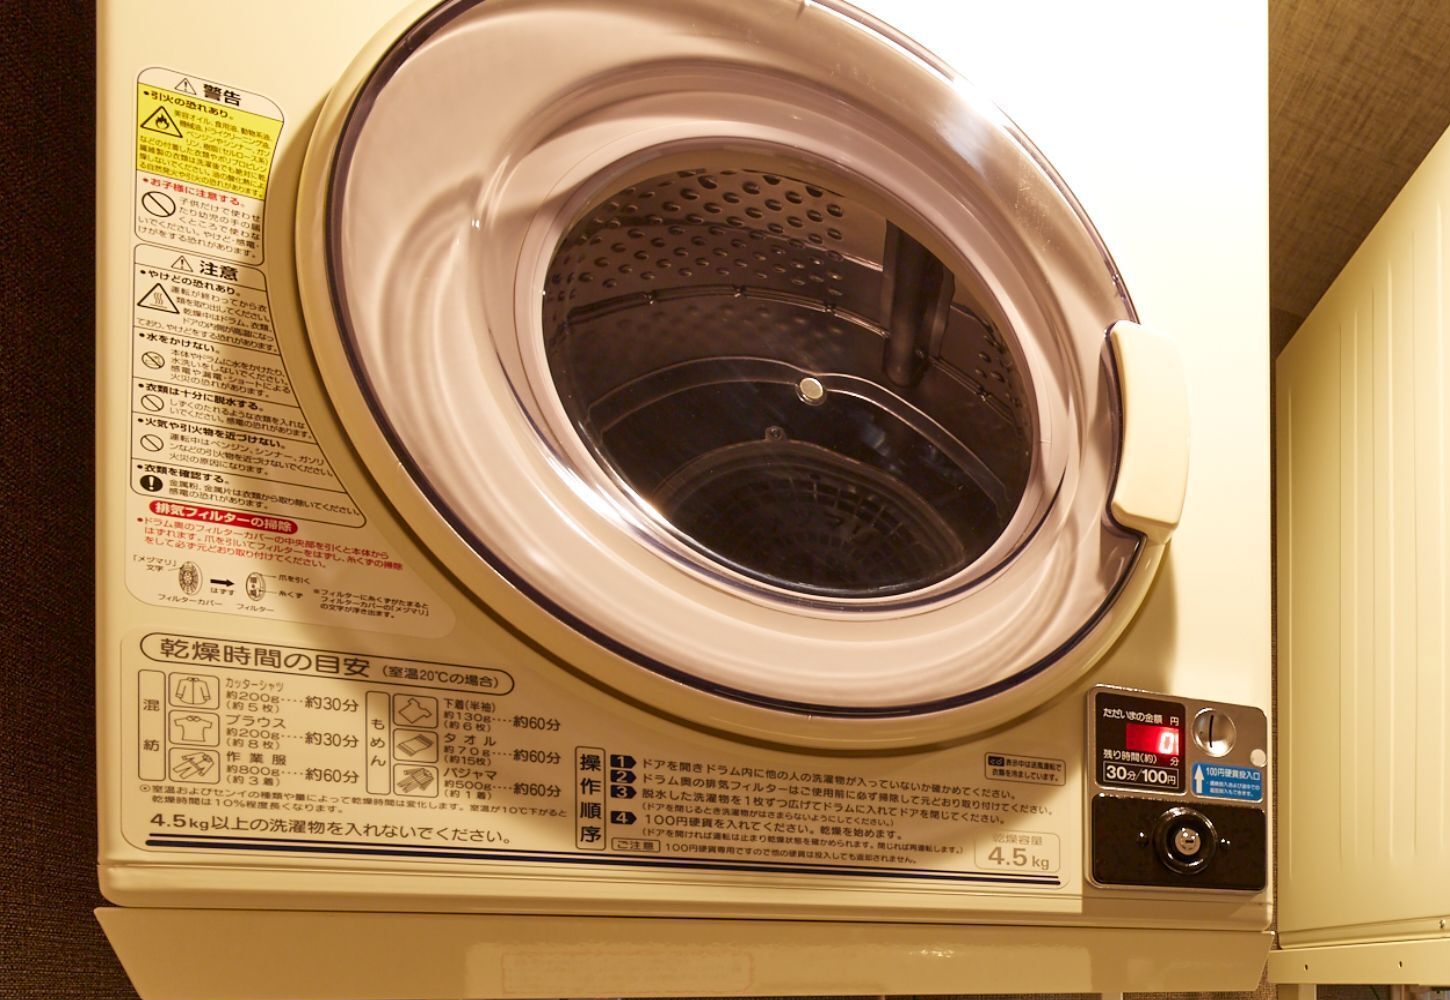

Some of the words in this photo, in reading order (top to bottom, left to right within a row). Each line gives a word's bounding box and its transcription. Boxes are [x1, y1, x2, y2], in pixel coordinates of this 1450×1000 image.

[204, 83, 241, 106] 警告
[151, 90, 234, 120] 引火の恐れあり。
[181, 198, 260, 222] 子供だけで使わせ
[179, 216, 260, 240] くところで使わな
[200, 260, 239, 281] 注意
[149, 270, 241, 297] やけどの恐れあり。
[147, 333, 220, 355] 水をかけない。
[146, 383, 263, 412] 衣類は十分に脱水する。
[145, 417, 285, 449] 火気や引火物を近づけない。
[145, 464, 230, 485] 衣類を確認する。
[155, 501, 293, 533] 排気フィルターの掃除
[146, 564, 164, 575] 文字
[158, 593, 223, 606] フィルターカバー
[210, 586, 235, 596] はずす
[238, 603, 275, 614] フィルター
[160, 637, 370, 678] 乾燥時間の目安
[225, 677, 284, 693] カッターシャツ
[304, 695, 360, 713] 約30分
[226, 713, 287, 729] ブラウス
[513, 715, 561, 732] 約60分
[1102, 707, 1163, 725] ただいまの金額
[304, 731, 360, 748] 約30分
[444, 733, 496, 747] タオル
[513, 748, 561, 765] 約60分
[304, 768, 360, 784] 約60分
[1105, 765, 1176, 785] 30分/100円
[513, 781, 561, 799] 約60分
[150, 813, 511, 845] 4.5kg以上の洗濯物を入れないでください。
[617, 840, 654, 850] ご注意
